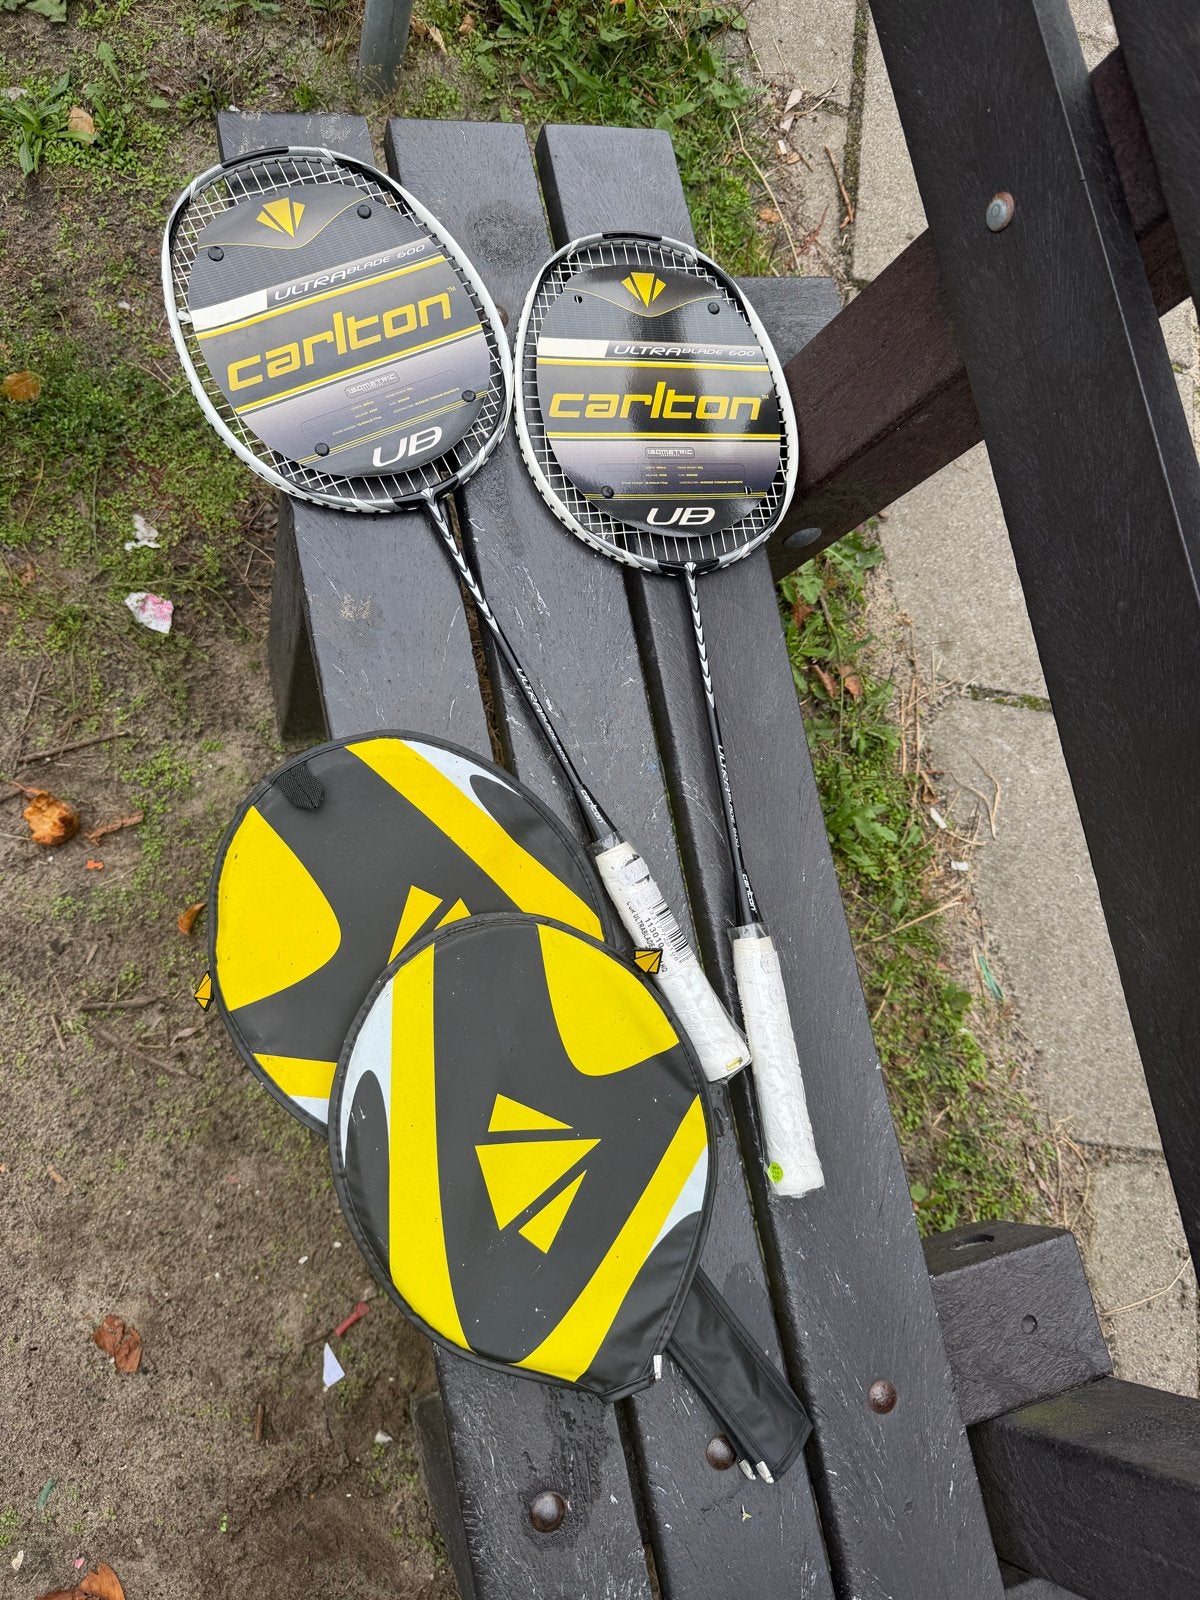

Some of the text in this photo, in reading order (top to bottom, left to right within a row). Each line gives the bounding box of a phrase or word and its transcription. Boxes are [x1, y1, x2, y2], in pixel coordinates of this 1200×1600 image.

[397, 244, 425, 259] 600
[227, 292, 452, 392] carlton
[548, 381, 761, 421] carlton
[372, 426, 443, 468] UB
[646, 507, 716, 526] UB
[580, 788, 605, 824] carlton
